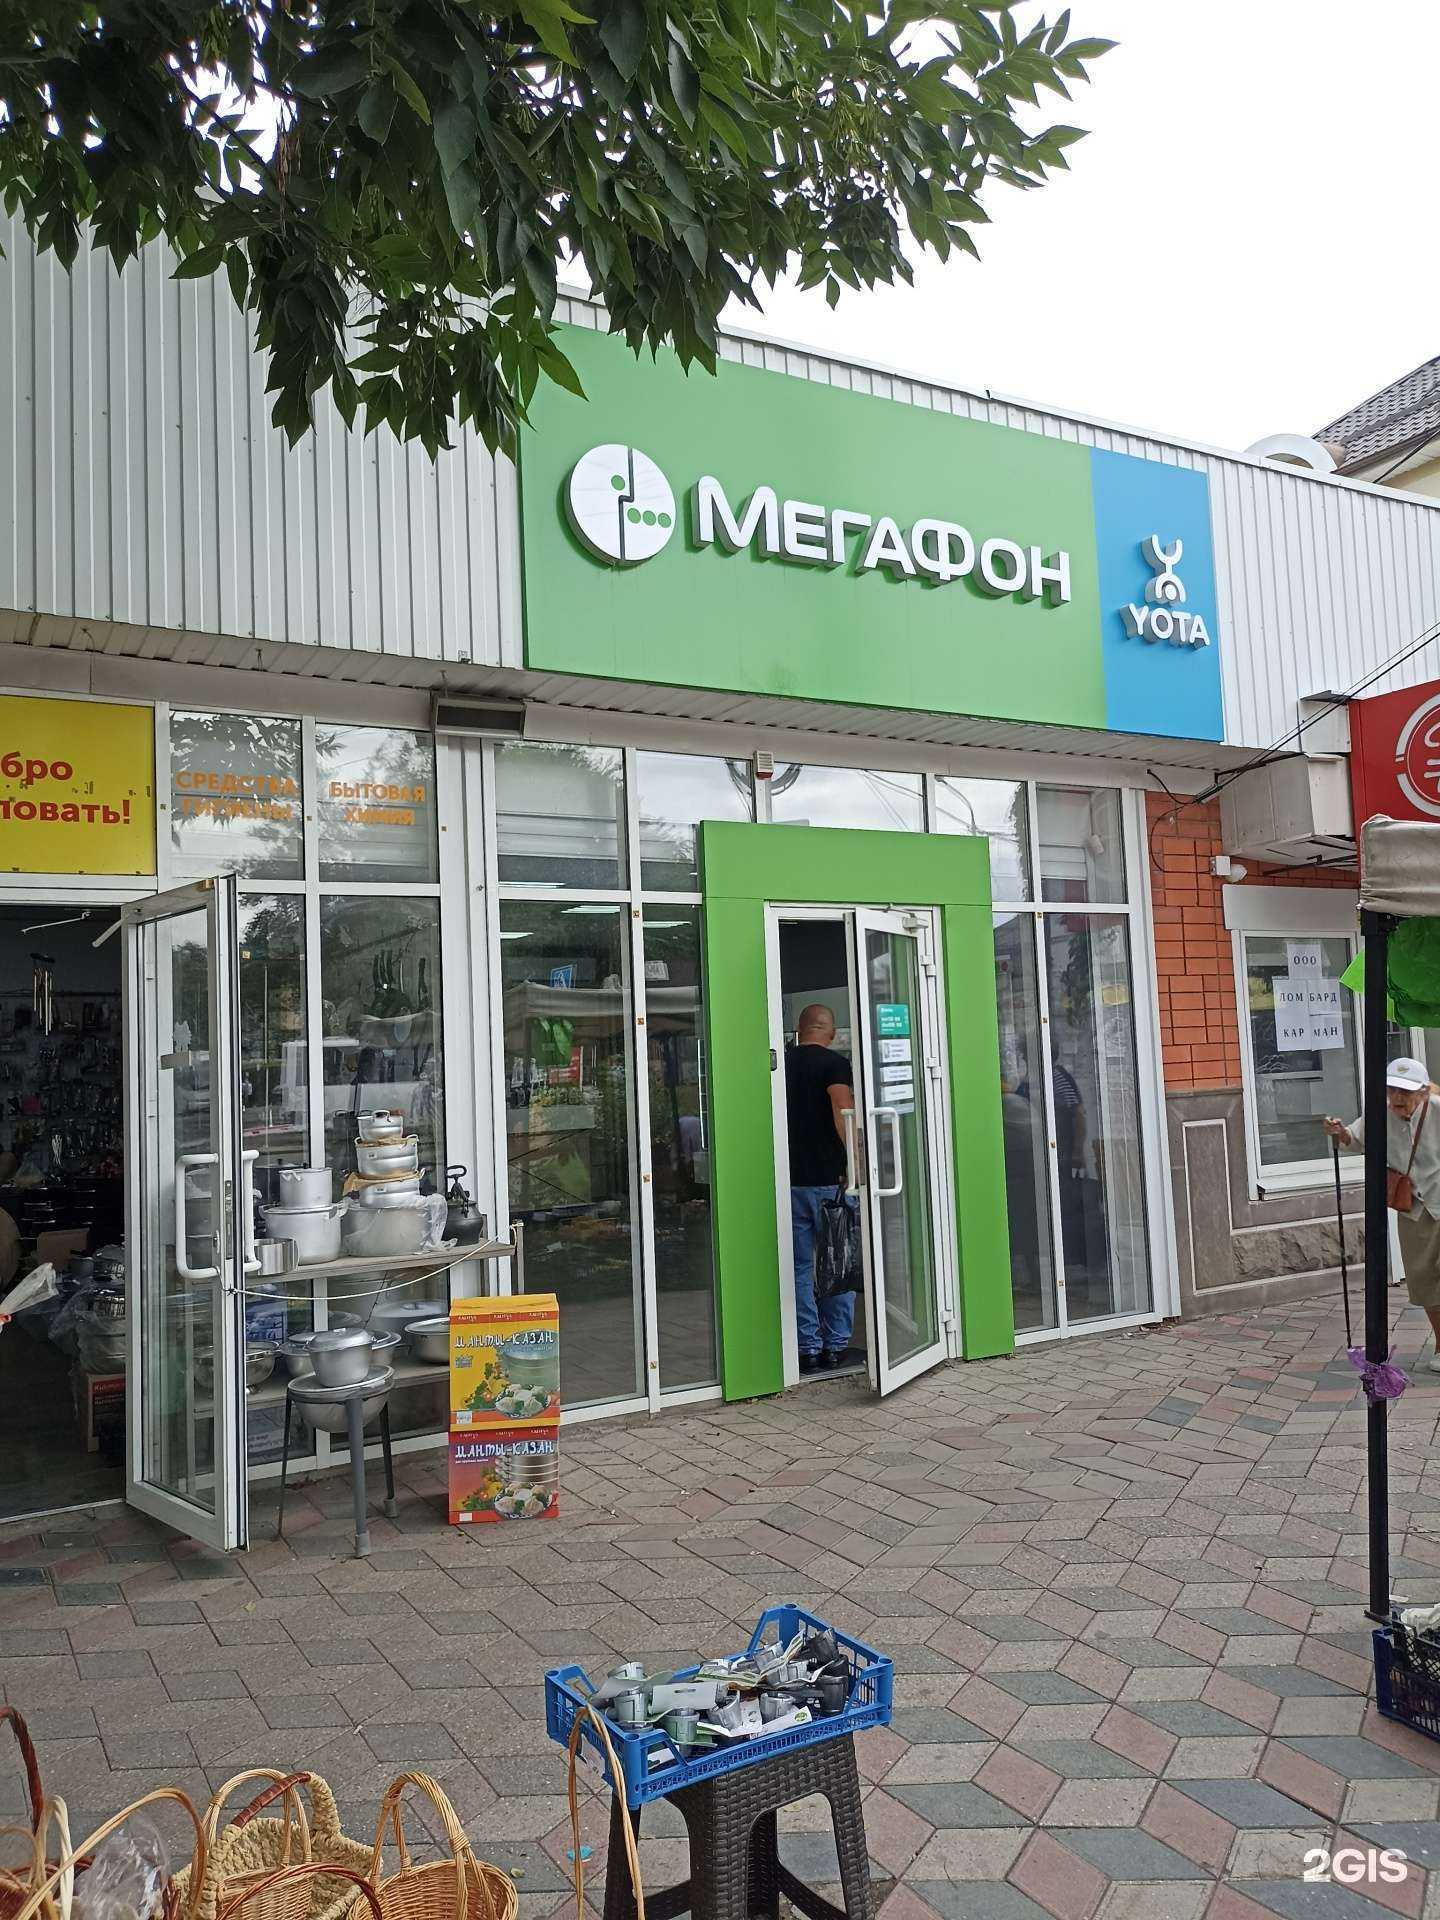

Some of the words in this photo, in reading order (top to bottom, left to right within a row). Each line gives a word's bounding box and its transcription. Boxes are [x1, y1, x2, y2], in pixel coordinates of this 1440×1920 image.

[692, 475, 1071, 602] МЕГАФОН
[1122, 602, 1211, 648] YOTA
[176, 771, 297, 796] СРЕДСТВА
[329, 781, 426, 801] БЫТОВАЯ
[344, 806, 415, 825] ХИМИЯ
